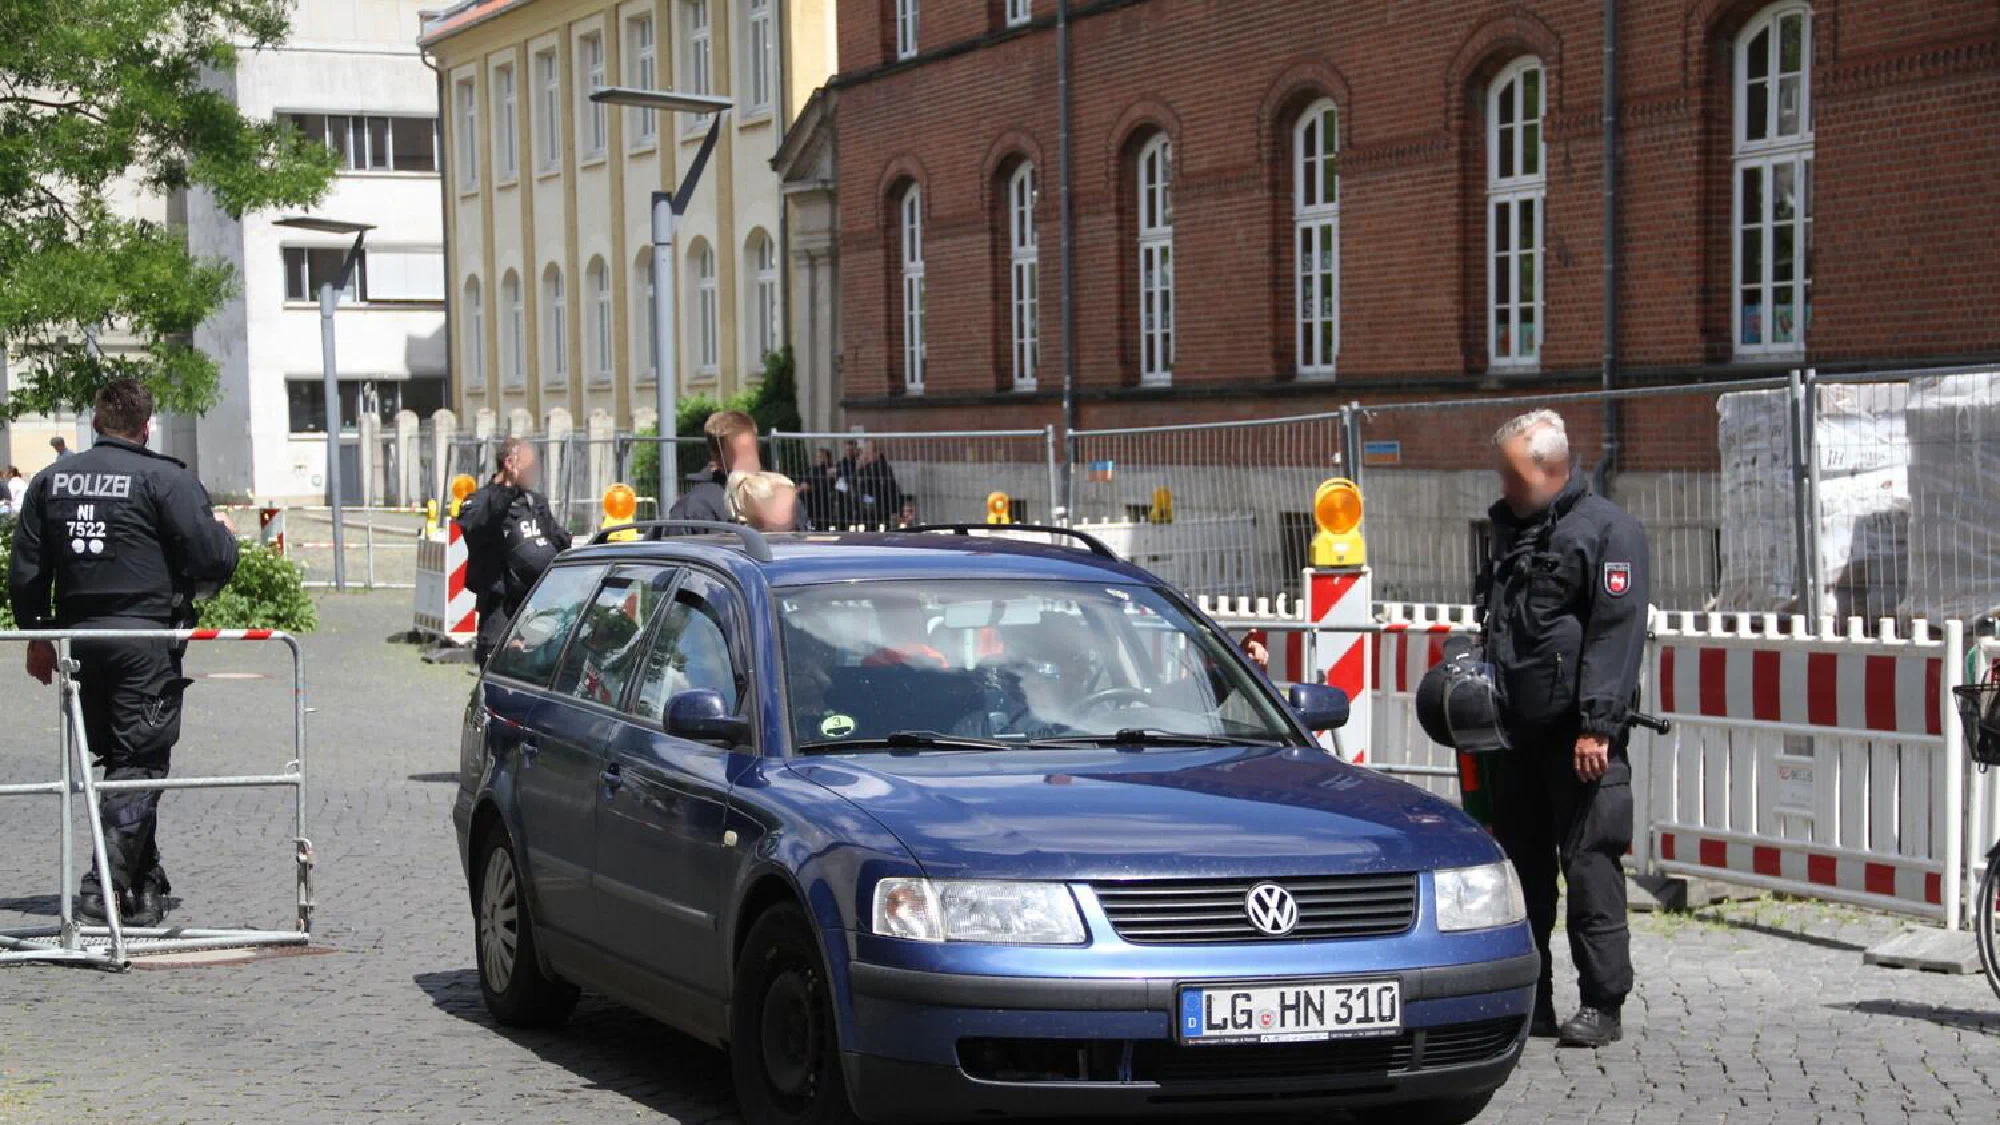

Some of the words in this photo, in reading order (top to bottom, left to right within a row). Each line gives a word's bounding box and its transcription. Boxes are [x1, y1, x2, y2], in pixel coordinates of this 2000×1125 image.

[52, 473, 131, 497] POLIZEI
[77, 504, 94, 521] NI
[66, 521, 106, 538] 7522
[1248, 884, 1297, 934] VW
[1205, 993, 1253, 1031] LG
[1279, 990, 1325, 1027] HN
[1334, 986, 1397, 1023] 310
[1187, 1017, 1197, 1028] D
